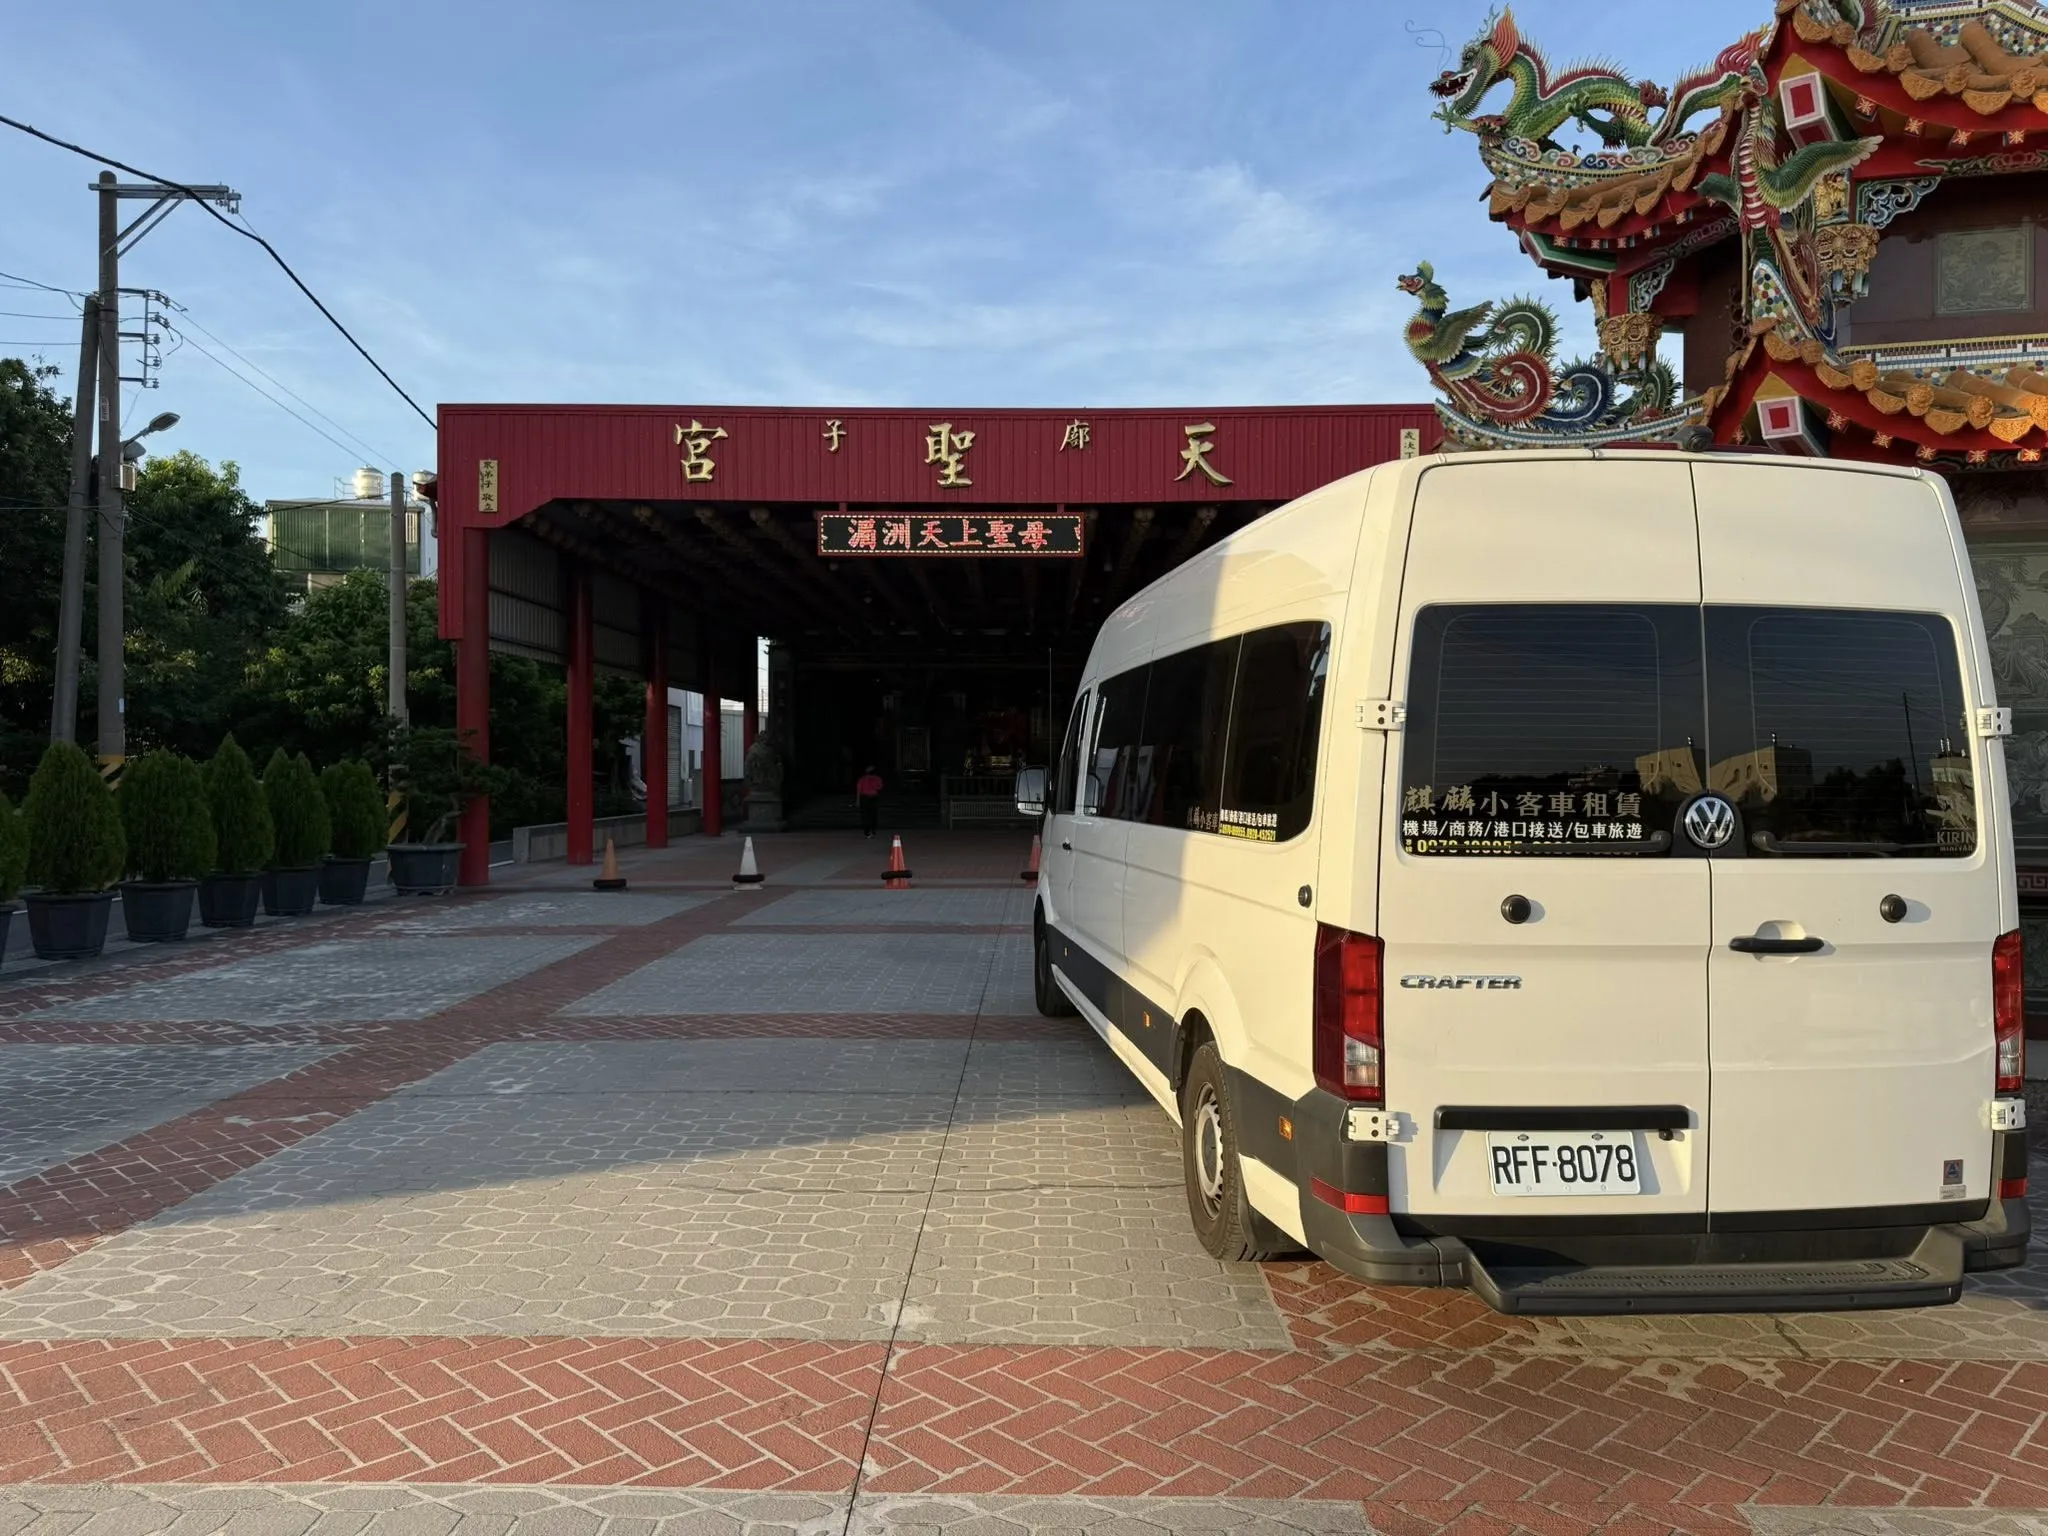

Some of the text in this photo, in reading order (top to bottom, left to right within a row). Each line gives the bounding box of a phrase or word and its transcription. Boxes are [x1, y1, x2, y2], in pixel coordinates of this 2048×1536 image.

[1401, 785, 1642, 818] 麒麟小客車租賃
[1402, 820, 1643, 839] 機場/商務/港口接送/包車旅遊
[1936, 831, 1976, 845] KIRIN
[1400, 974, 1523, 989] CRAFTER
